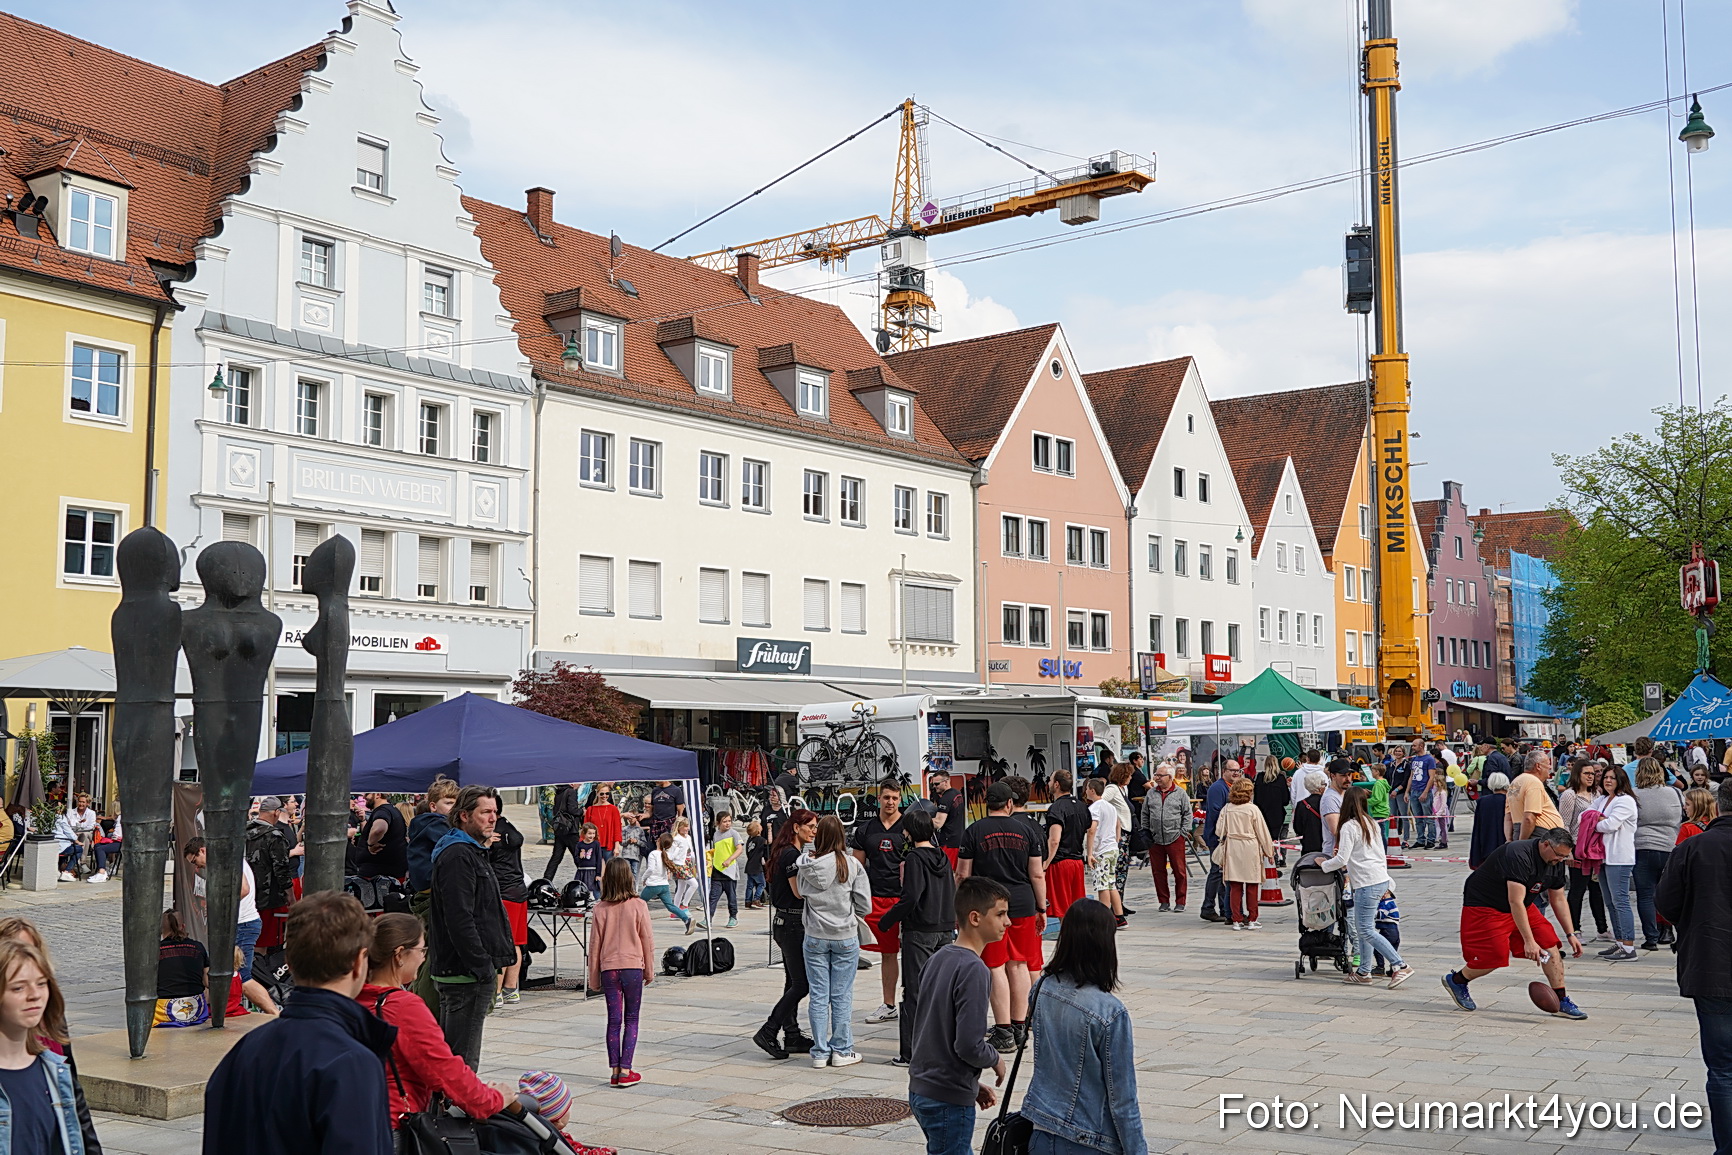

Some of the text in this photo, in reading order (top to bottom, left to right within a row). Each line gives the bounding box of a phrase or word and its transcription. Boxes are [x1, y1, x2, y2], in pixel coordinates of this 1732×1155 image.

[1379, 136, 1391, 205] MIKSCHL
[944, 205, 993, 223] LIEBHERR
[302, 467, 442, 505] BRILLEN WEBER
[1383, 429, 1406, 553] MIKSCHL
[349, 635, 409, 649] MOBILIEN
[741, 641, 809, 671] frühauf
[1212, 659, 1231, 673] WITT
[1276, 716, 1294, 726] AOK
